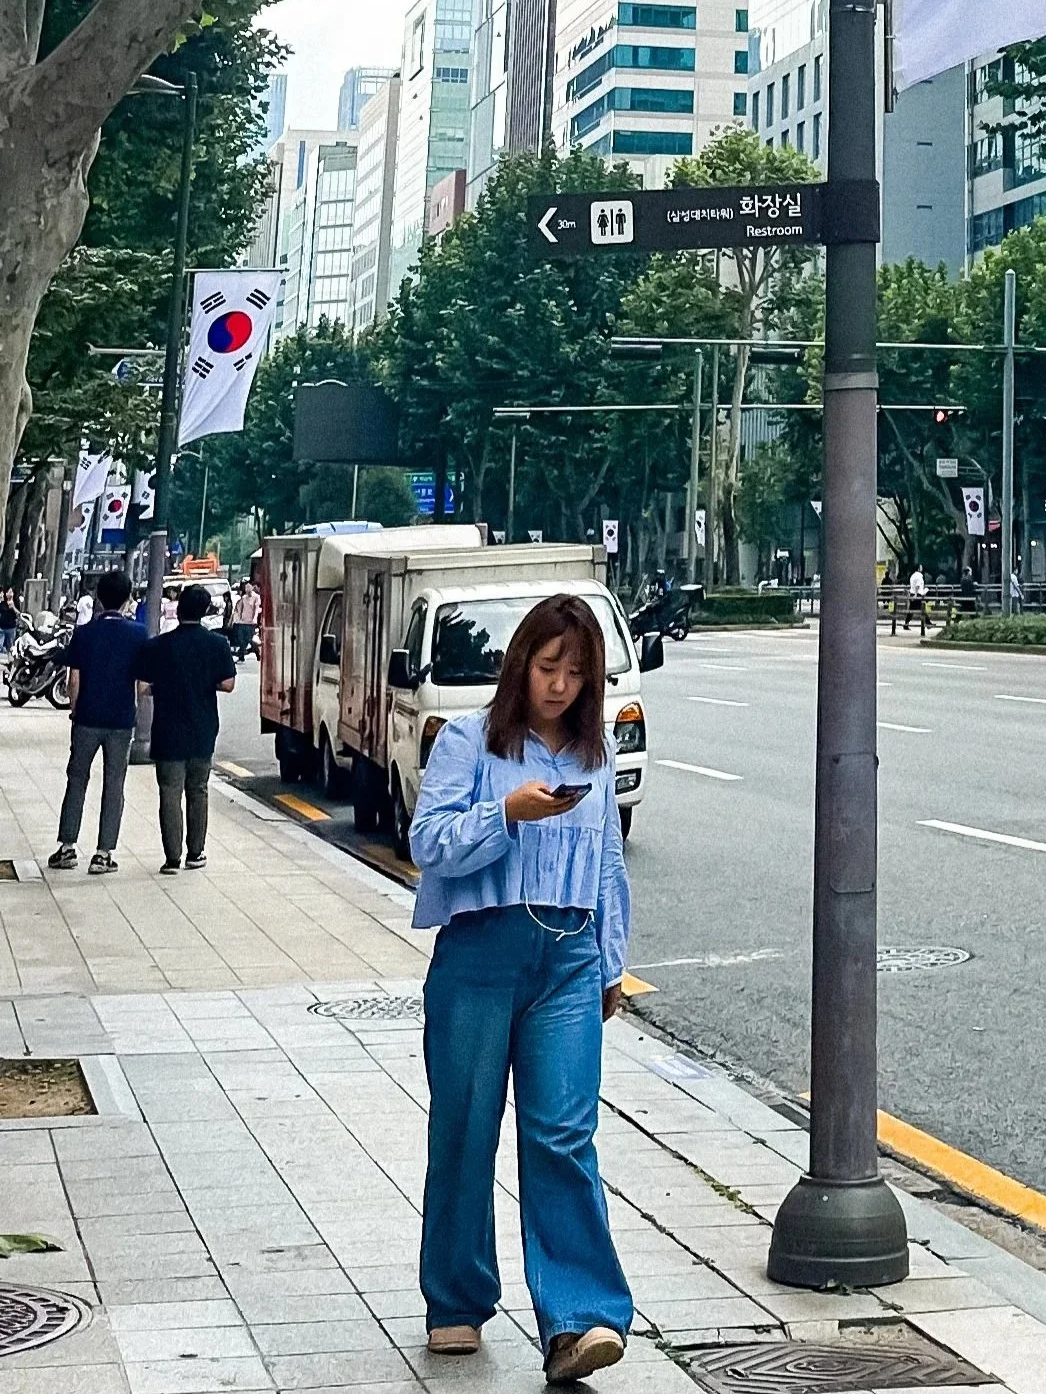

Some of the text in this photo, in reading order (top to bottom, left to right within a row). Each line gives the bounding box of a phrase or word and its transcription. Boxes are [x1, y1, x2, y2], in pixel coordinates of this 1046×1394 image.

[666, 193, 802, 223] (삼성대치타워) 화장실
[557, 219, 577, 230] 30m
[746, 224, 803, 238] Restroom
